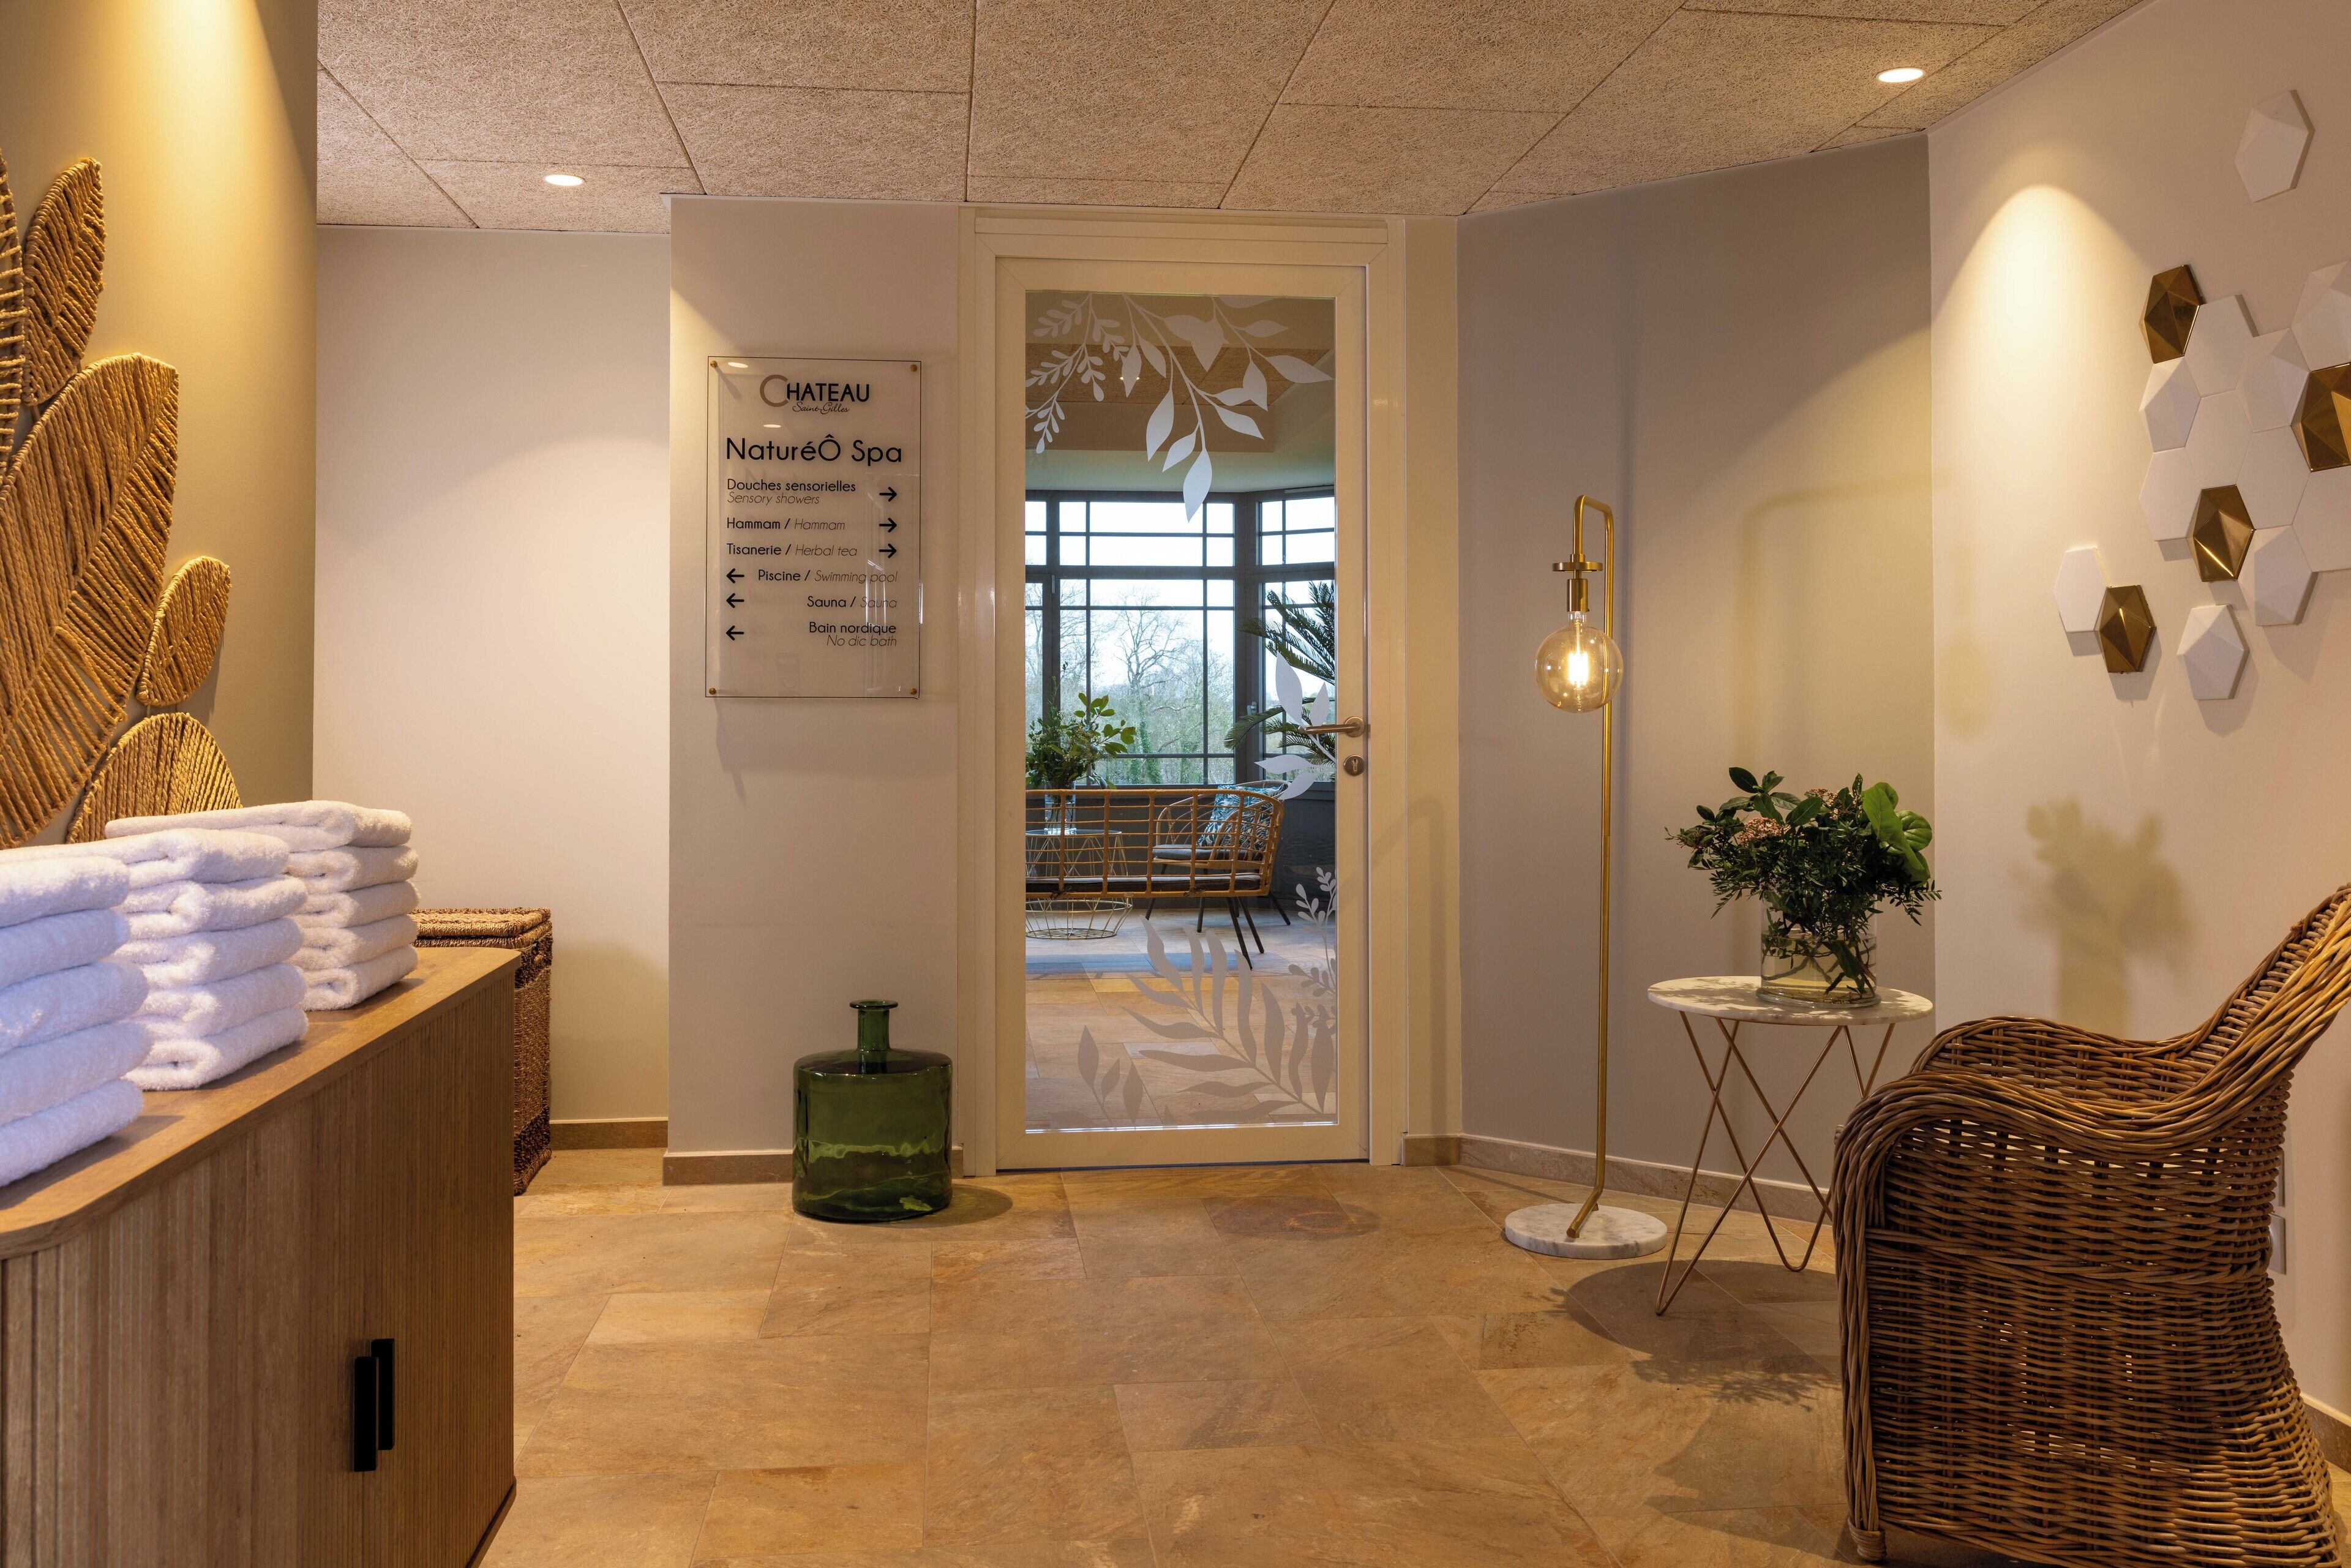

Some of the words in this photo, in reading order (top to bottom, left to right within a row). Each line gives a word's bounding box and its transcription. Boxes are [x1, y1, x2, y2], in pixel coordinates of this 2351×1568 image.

[760, 374, 870, 407] CHATEAU
[792, 401, 850, 415] Saint-Gilles
[727, 433, 841, 462] NaturéÔ
[852, 439, 902, 467] Spa
[727, 479, 781, 490] Douches
[786, 480, 856, 492] sensorielles
[727, 492, 772, 505] Sensory
[776, 493, 820, 505] showers
[727, 517, 781, 530] Hammam
[784, 518, 791, 530] /
[794, 519, 845, 530] Hammam
[727, 543, 782, 555] Tisanerie
[785, 544, 792, 555] /
[795, 544, 834, 556] Herbal
[838, 547, 858, 557] tea
[759, 569, 801, 581] Piscine
[804, 570, 811, 581] /
[814, 570, 867, 584] Swimming
[869, 571, 898, 585] pool
[807, 596, 847, 608] Sauna
[850, 596, 857, 607] /
[860, 596, 898, 608] Sauna
[809, 622, 836, 633] Bain
[841, 622, 897, 636] nordique
[870, 635, 897, 647] bath
